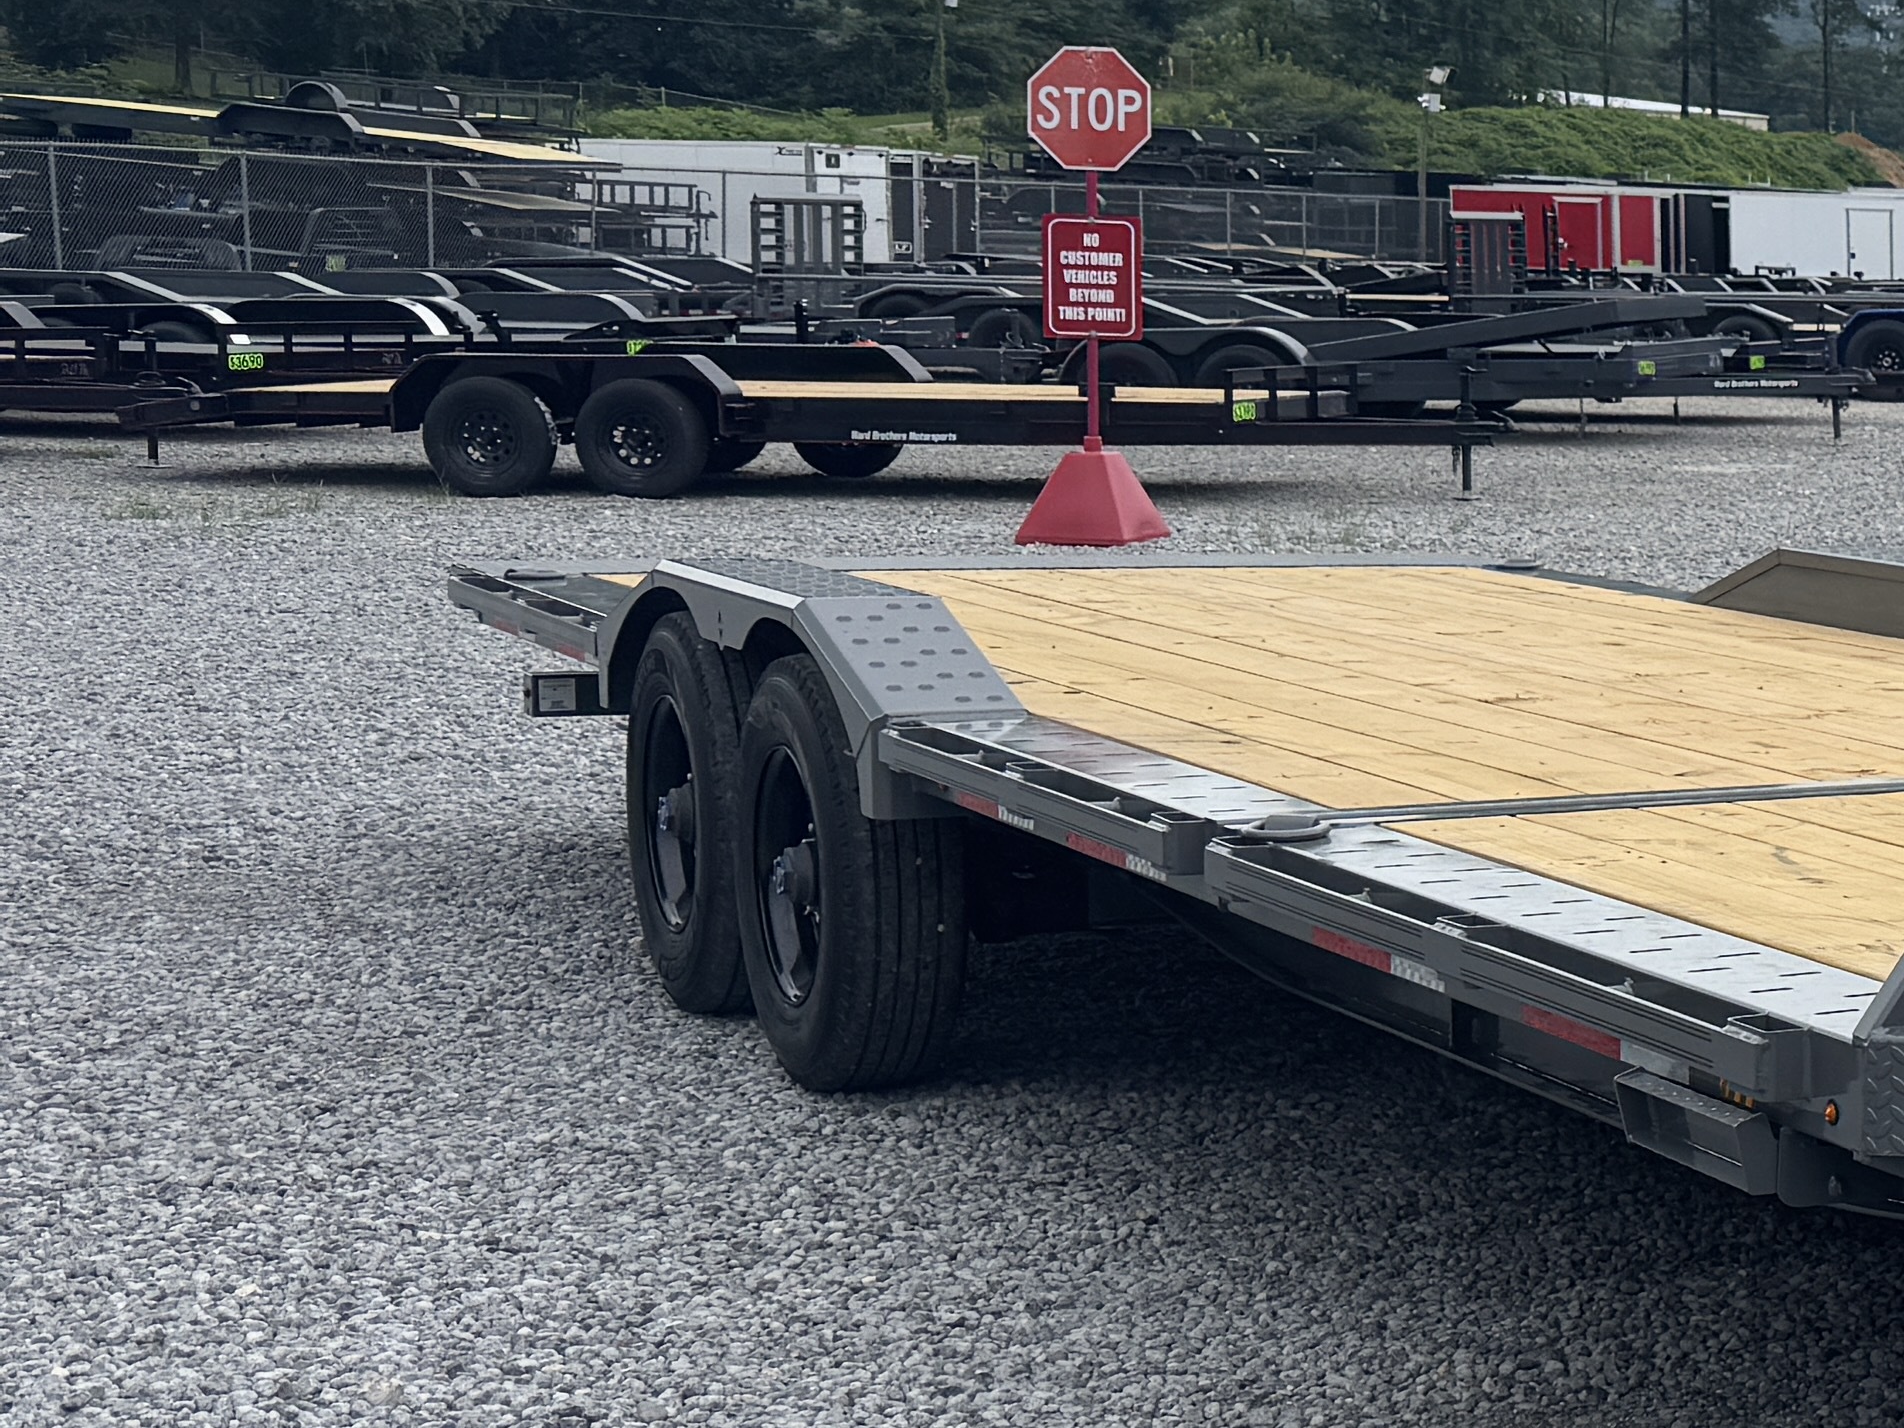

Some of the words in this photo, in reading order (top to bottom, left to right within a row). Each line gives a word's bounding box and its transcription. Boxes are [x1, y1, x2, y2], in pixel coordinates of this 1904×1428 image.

[1036, 85, 1143, 132] STOP
[1083, 233, 1100, 247] NO
[1060, 250, 1124, 267] CUSTOMER
[1062, 269, 1118, 285] VEHICLES
[1069, 288, 1115, 303] BEYOND
[1057, 306, 1086, 320] THIS
[1087, 307, 1126, 322] POINT!
